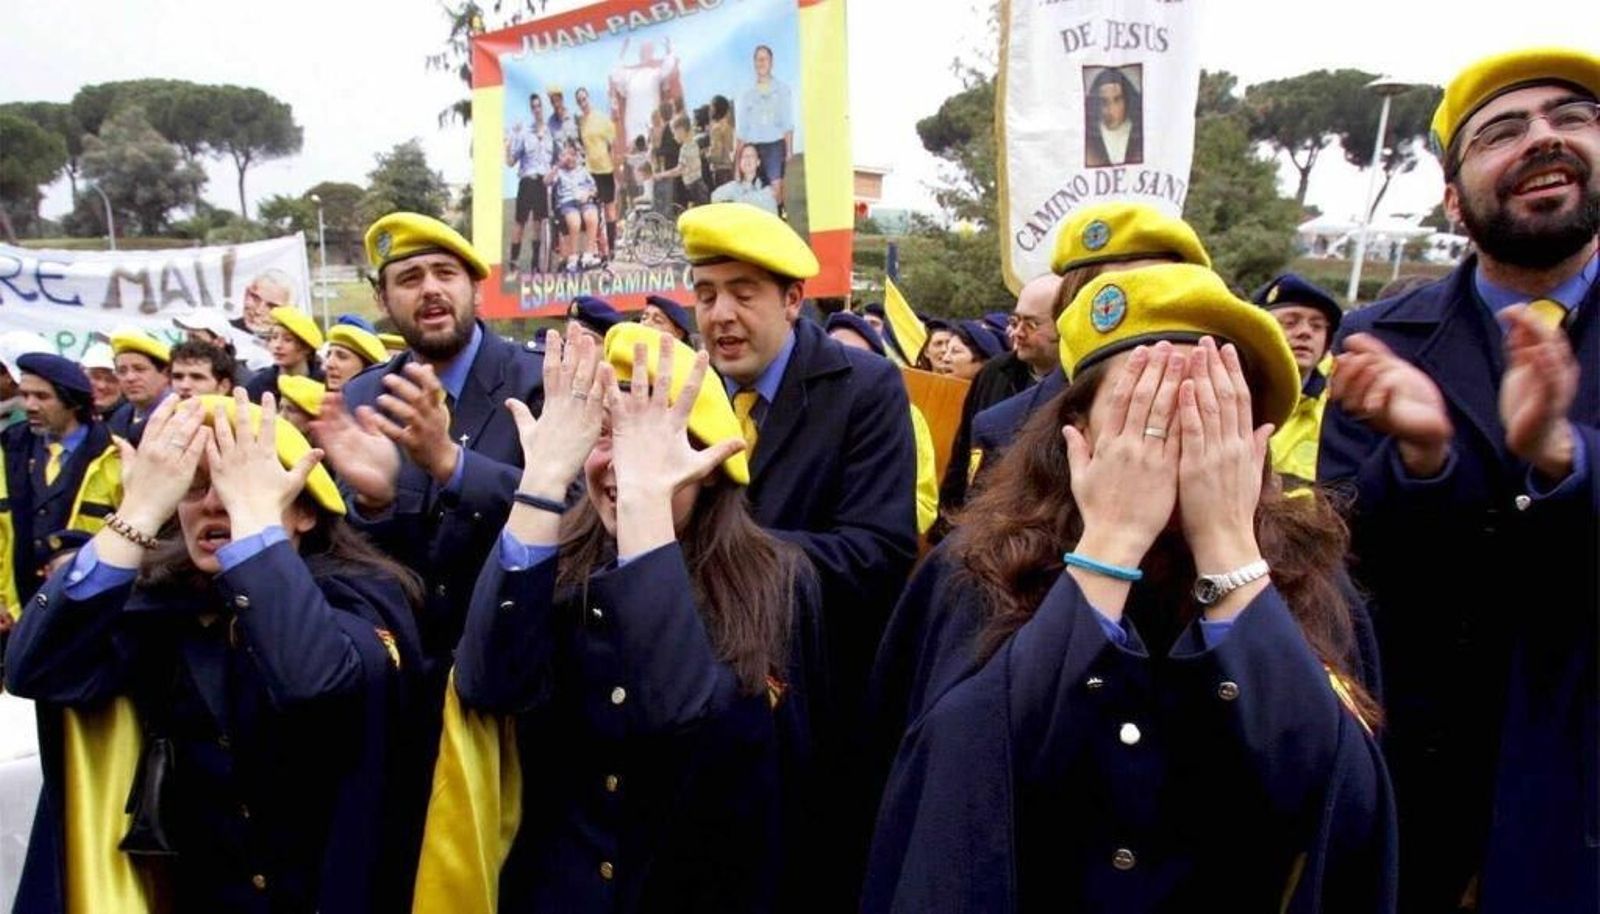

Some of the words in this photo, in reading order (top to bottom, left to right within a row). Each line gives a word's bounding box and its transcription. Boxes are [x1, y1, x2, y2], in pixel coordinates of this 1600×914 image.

[512, 22, 600, 61] JUAN
[1059, 21, 1096, 53] DE
[1103, 18, 1170, 53] JESUS
[1015, 174, 1090, 252] CAMINO
[1094, 167, 1128, 196] DE
[102, 249, 237, 315] MAI!
[599, 267, 676, 297] CAMINA
